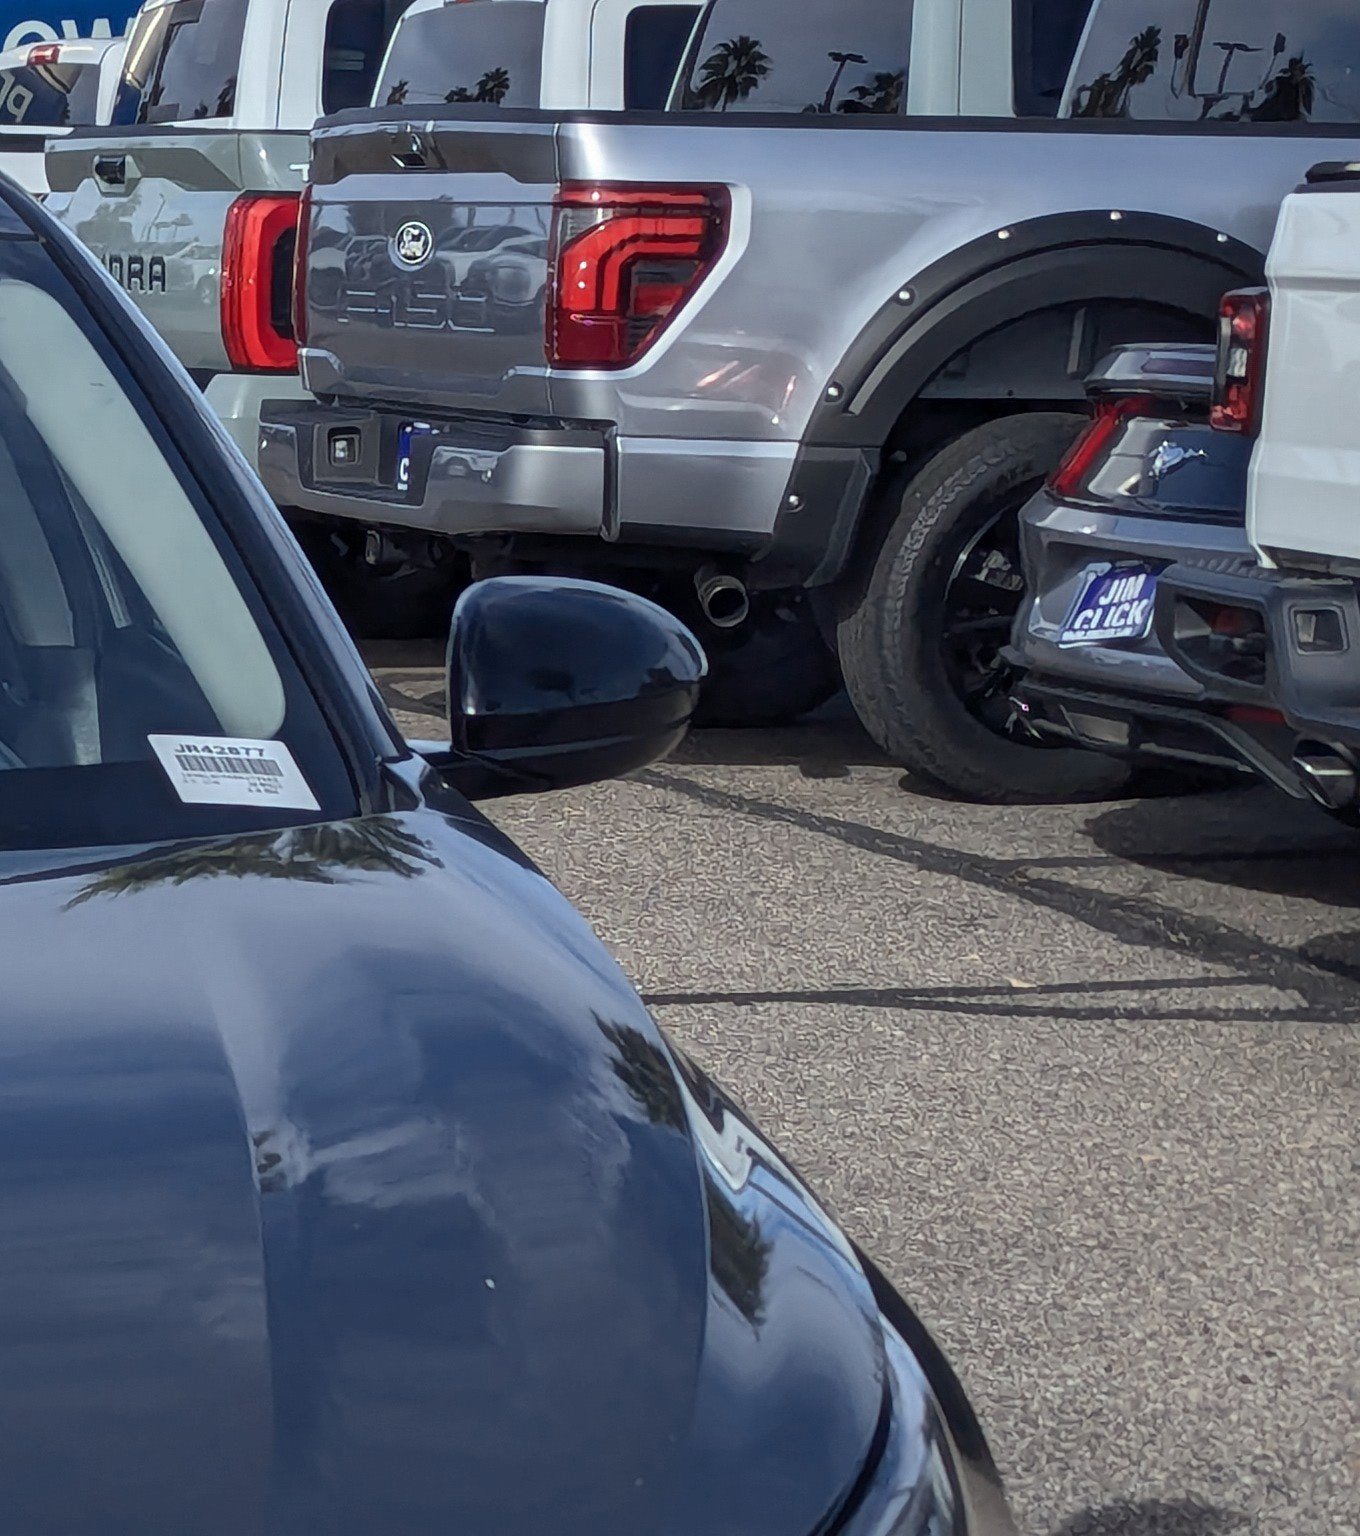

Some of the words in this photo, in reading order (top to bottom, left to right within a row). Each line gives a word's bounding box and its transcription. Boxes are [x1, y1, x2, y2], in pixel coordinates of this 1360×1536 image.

[101, 253, 167, 294] DRA
[1098, 573, 1147, 606] JIM
[1074, 598, 1150, 630] CLICK
